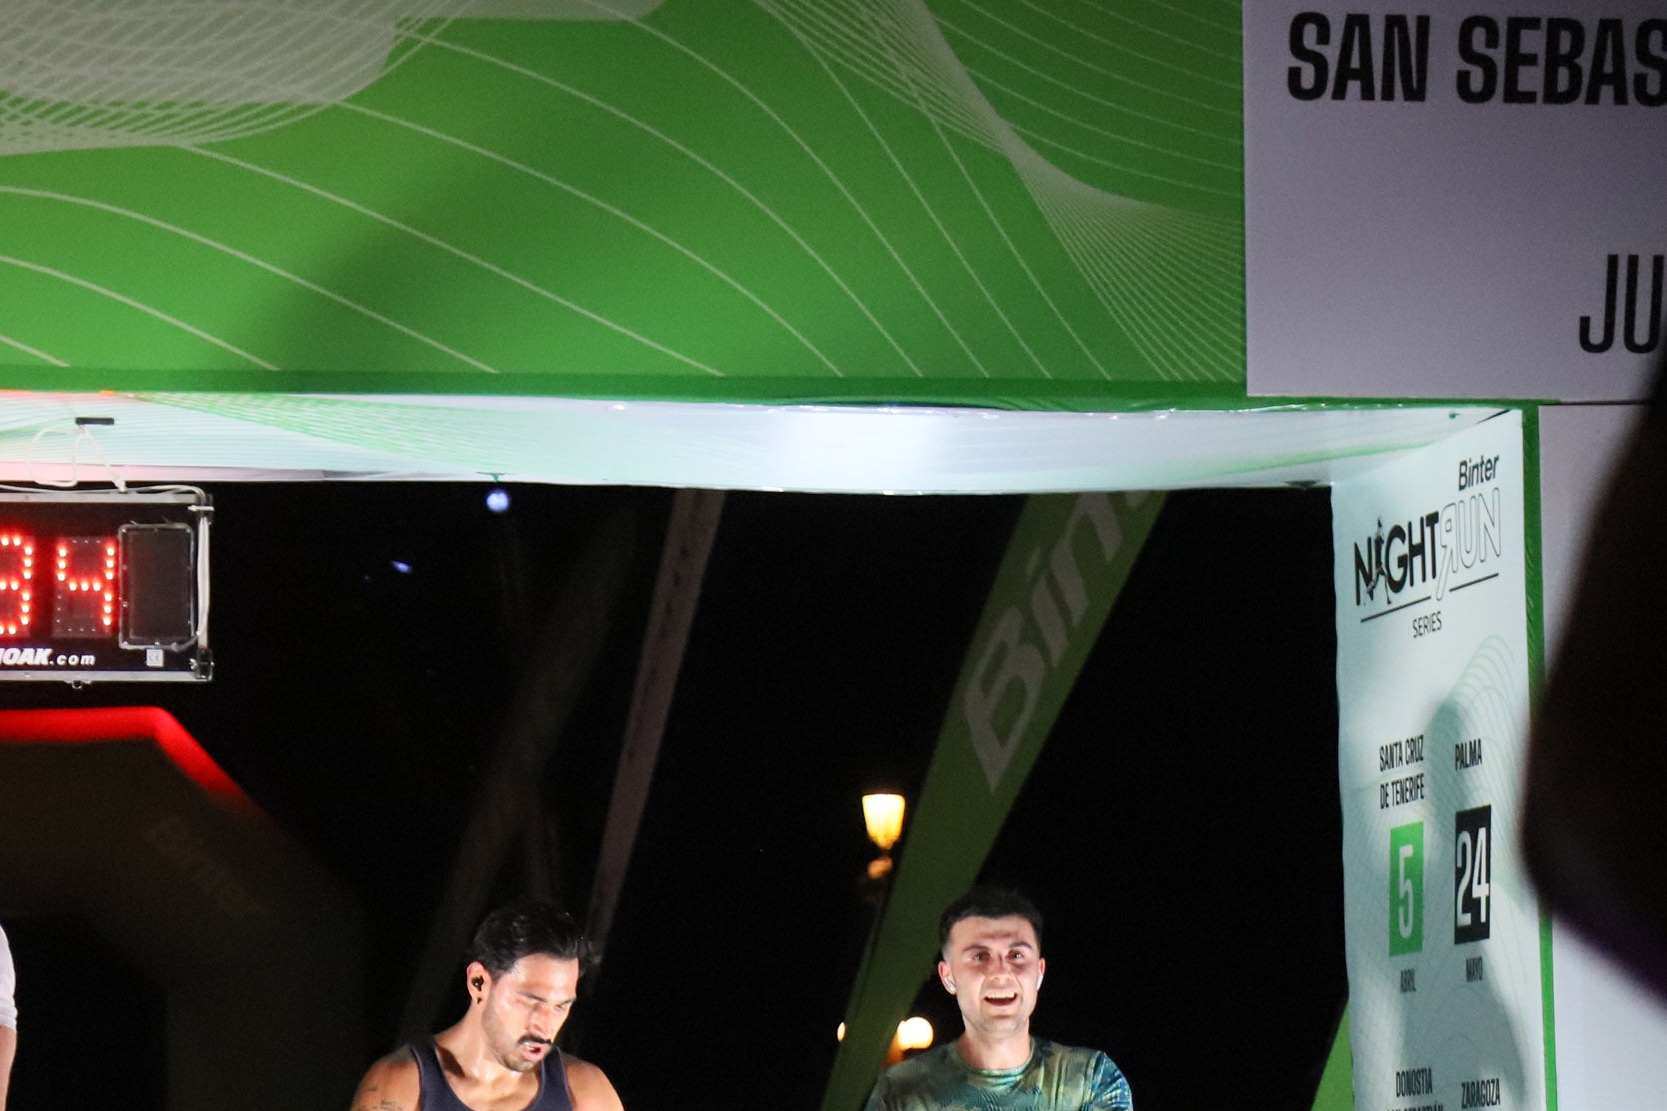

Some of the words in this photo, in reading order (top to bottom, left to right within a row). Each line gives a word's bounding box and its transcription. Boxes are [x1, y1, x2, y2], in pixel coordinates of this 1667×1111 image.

[1287, 11, 1430, 102] SAN
[1458, 455, 1500, 491] Binter
[1412, 611, 1443, 638] SERIES
[1379, 741, 1403, 773] SANTA
[1405, 735, 1424, 764] CRUZ
[1455, 738, 1483, 771] PALMA
[1380, 782, 1389, 809] DE
[1391, 773, 1425, 806] TENERIFE
[1398, 844, 1414, 939] 5
[1456, 827, 1490, 926] 24
[1466, 956, 1483, 982] MAYO
[1395, 1067, 1433, 1098] DONOSTIA
[1461, 1078, 1501, 1109] ZARAGOZA
